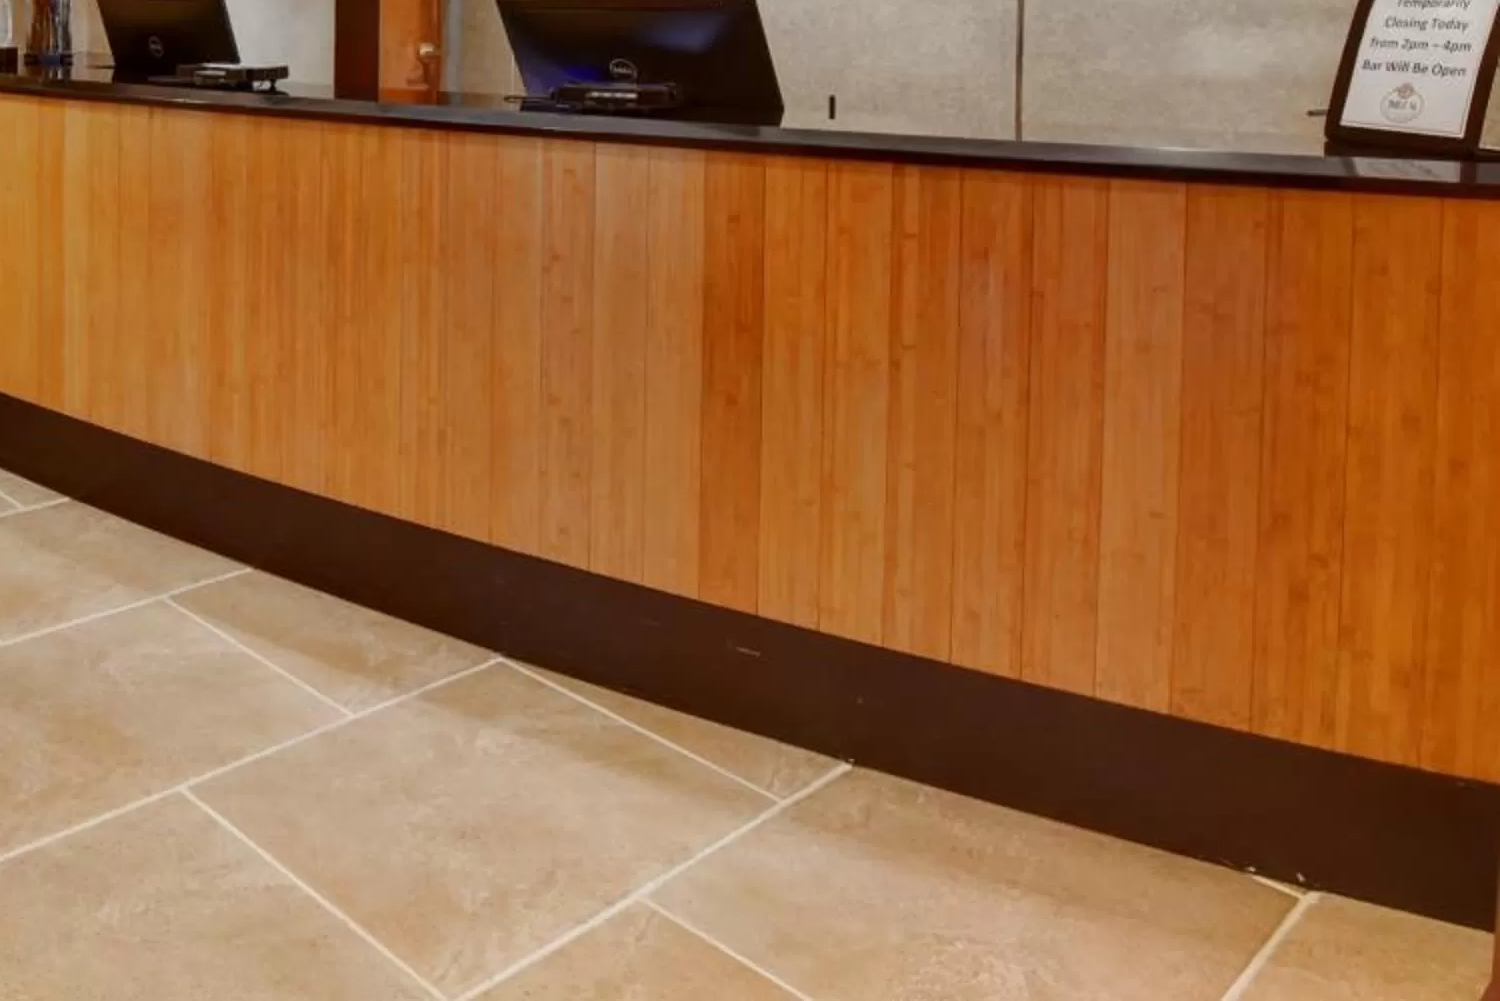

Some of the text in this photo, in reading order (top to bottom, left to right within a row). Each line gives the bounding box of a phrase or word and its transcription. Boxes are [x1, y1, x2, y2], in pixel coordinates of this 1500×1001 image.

[1384, 16, 1469, 33] Closing Today
[1361, 59, 1467, 77] Bar Will Be Open
